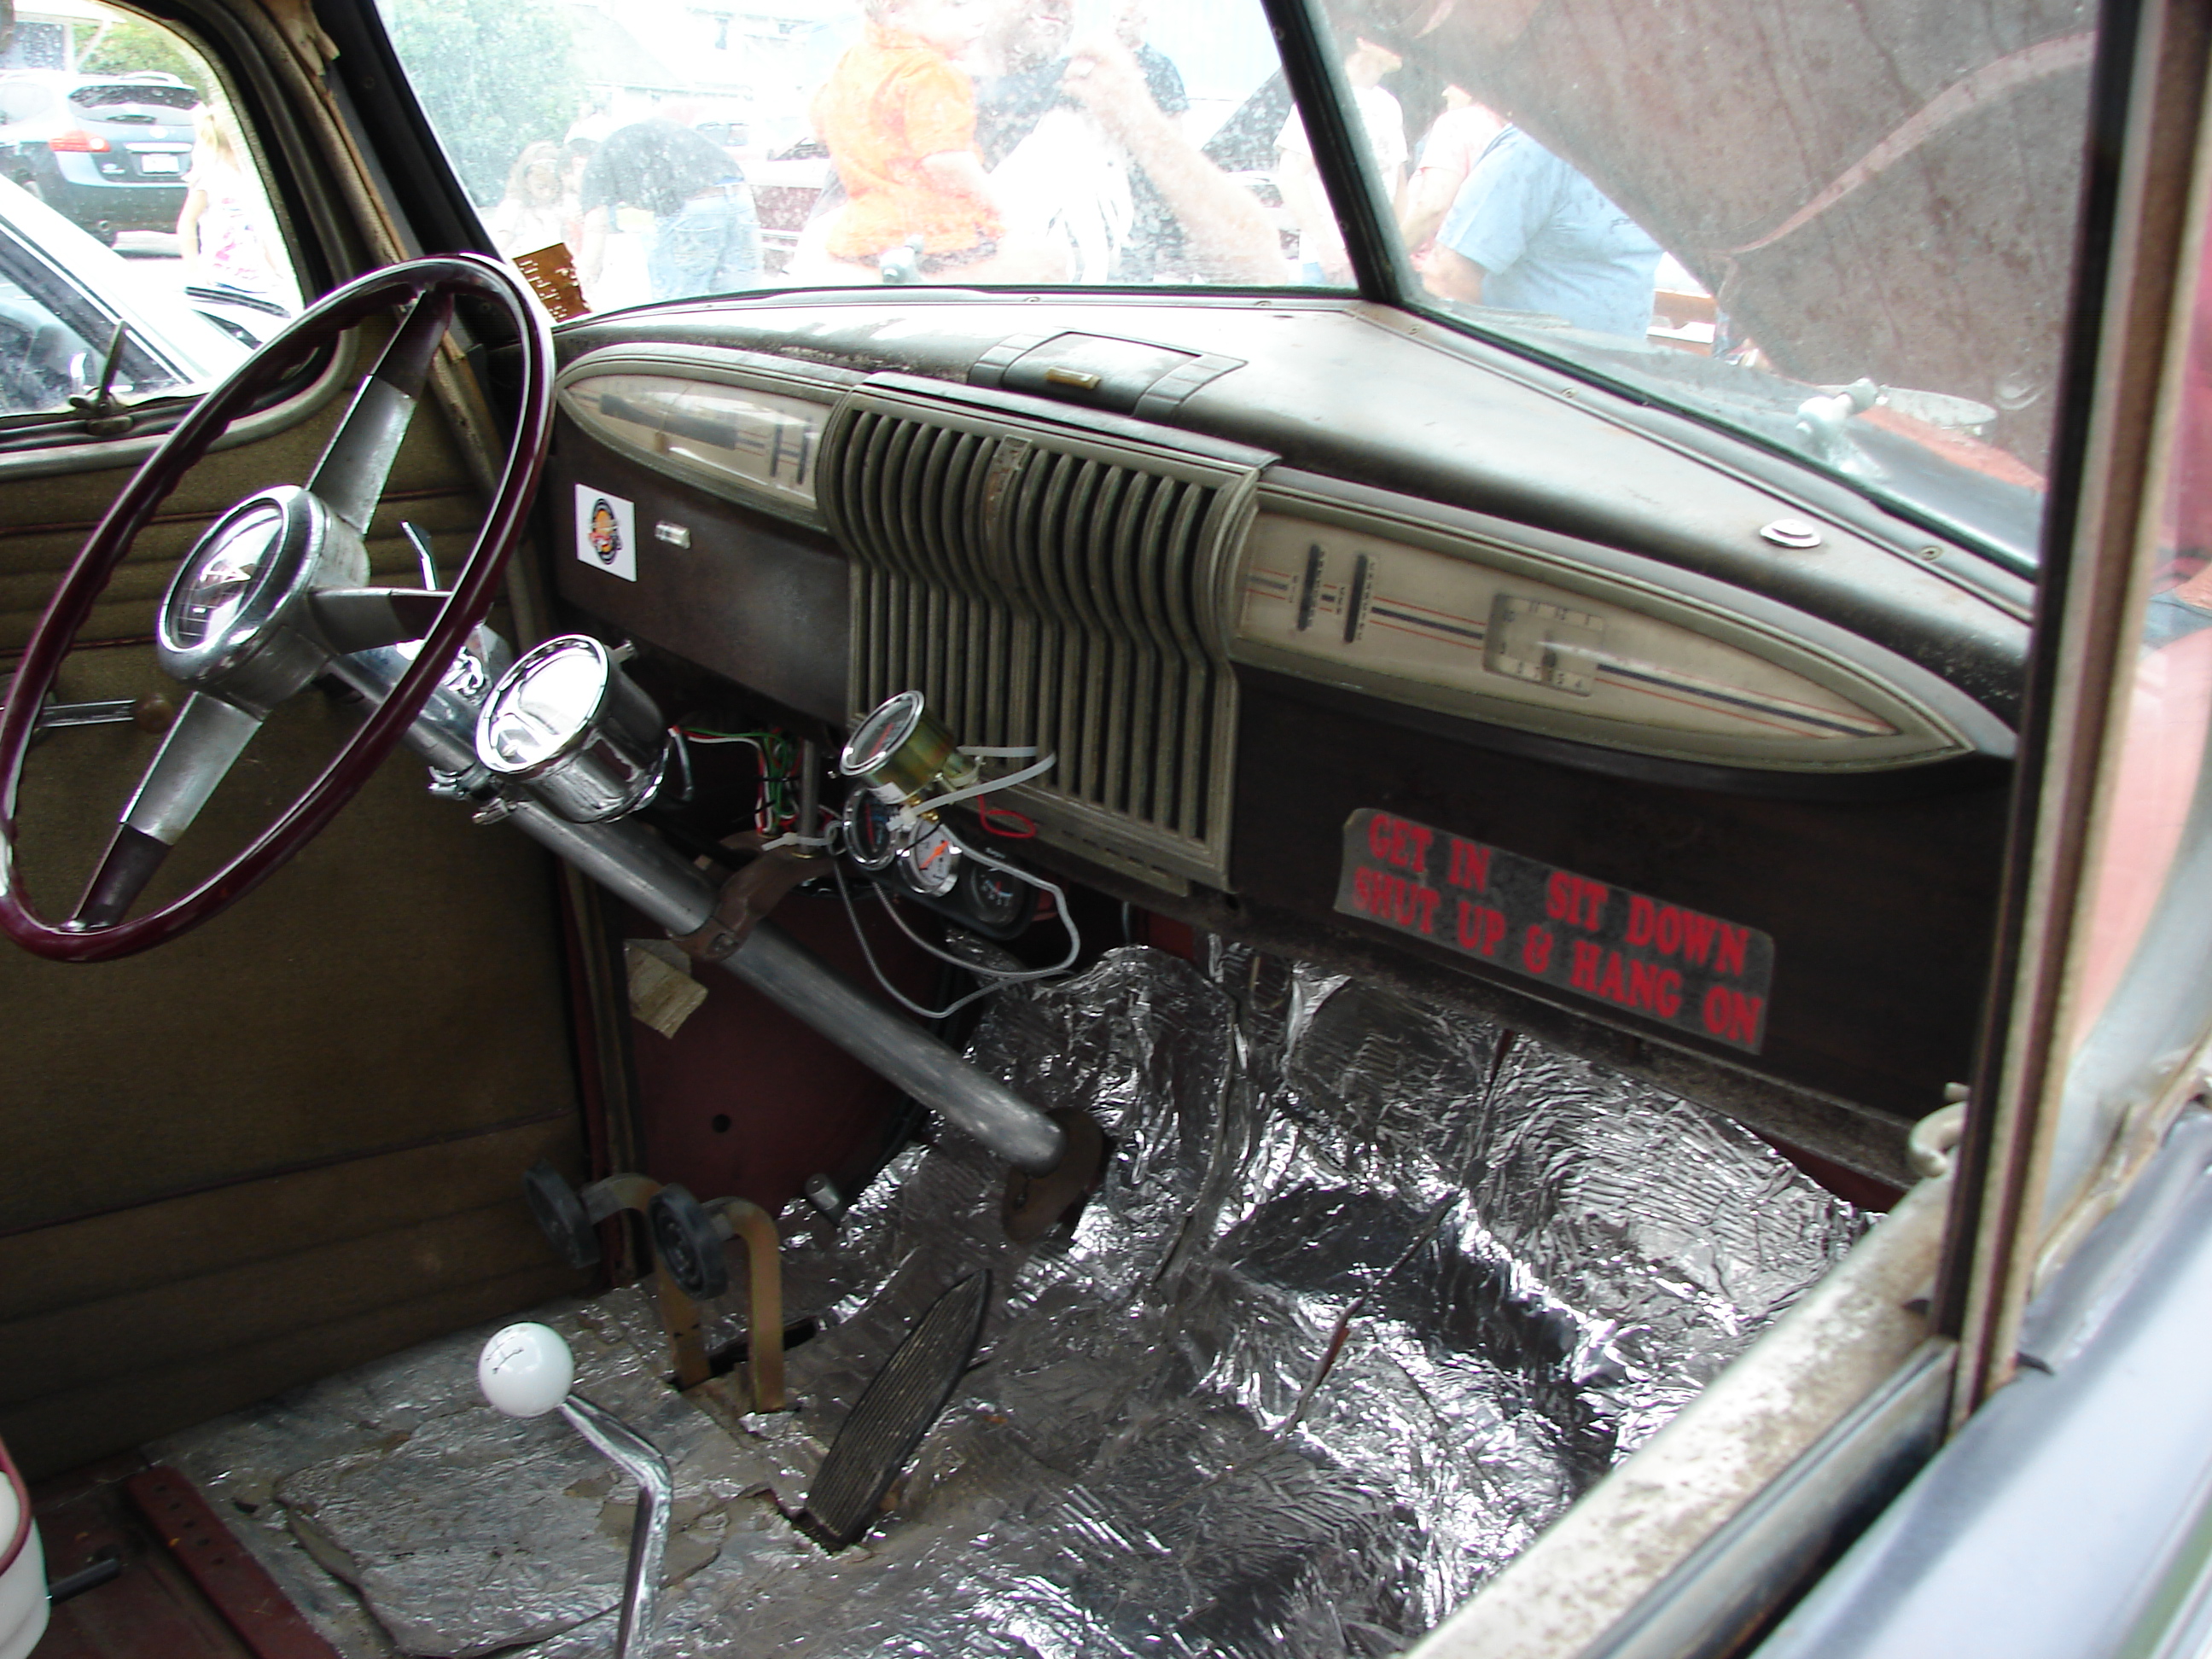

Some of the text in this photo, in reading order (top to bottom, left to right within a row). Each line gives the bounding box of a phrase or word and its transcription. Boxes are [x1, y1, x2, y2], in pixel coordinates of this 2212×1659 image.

[1354, 866, 1762, 1044] SHUT UP & HANG ON
[1369, 814, 1749, 976] GET IN SIT DOWN
